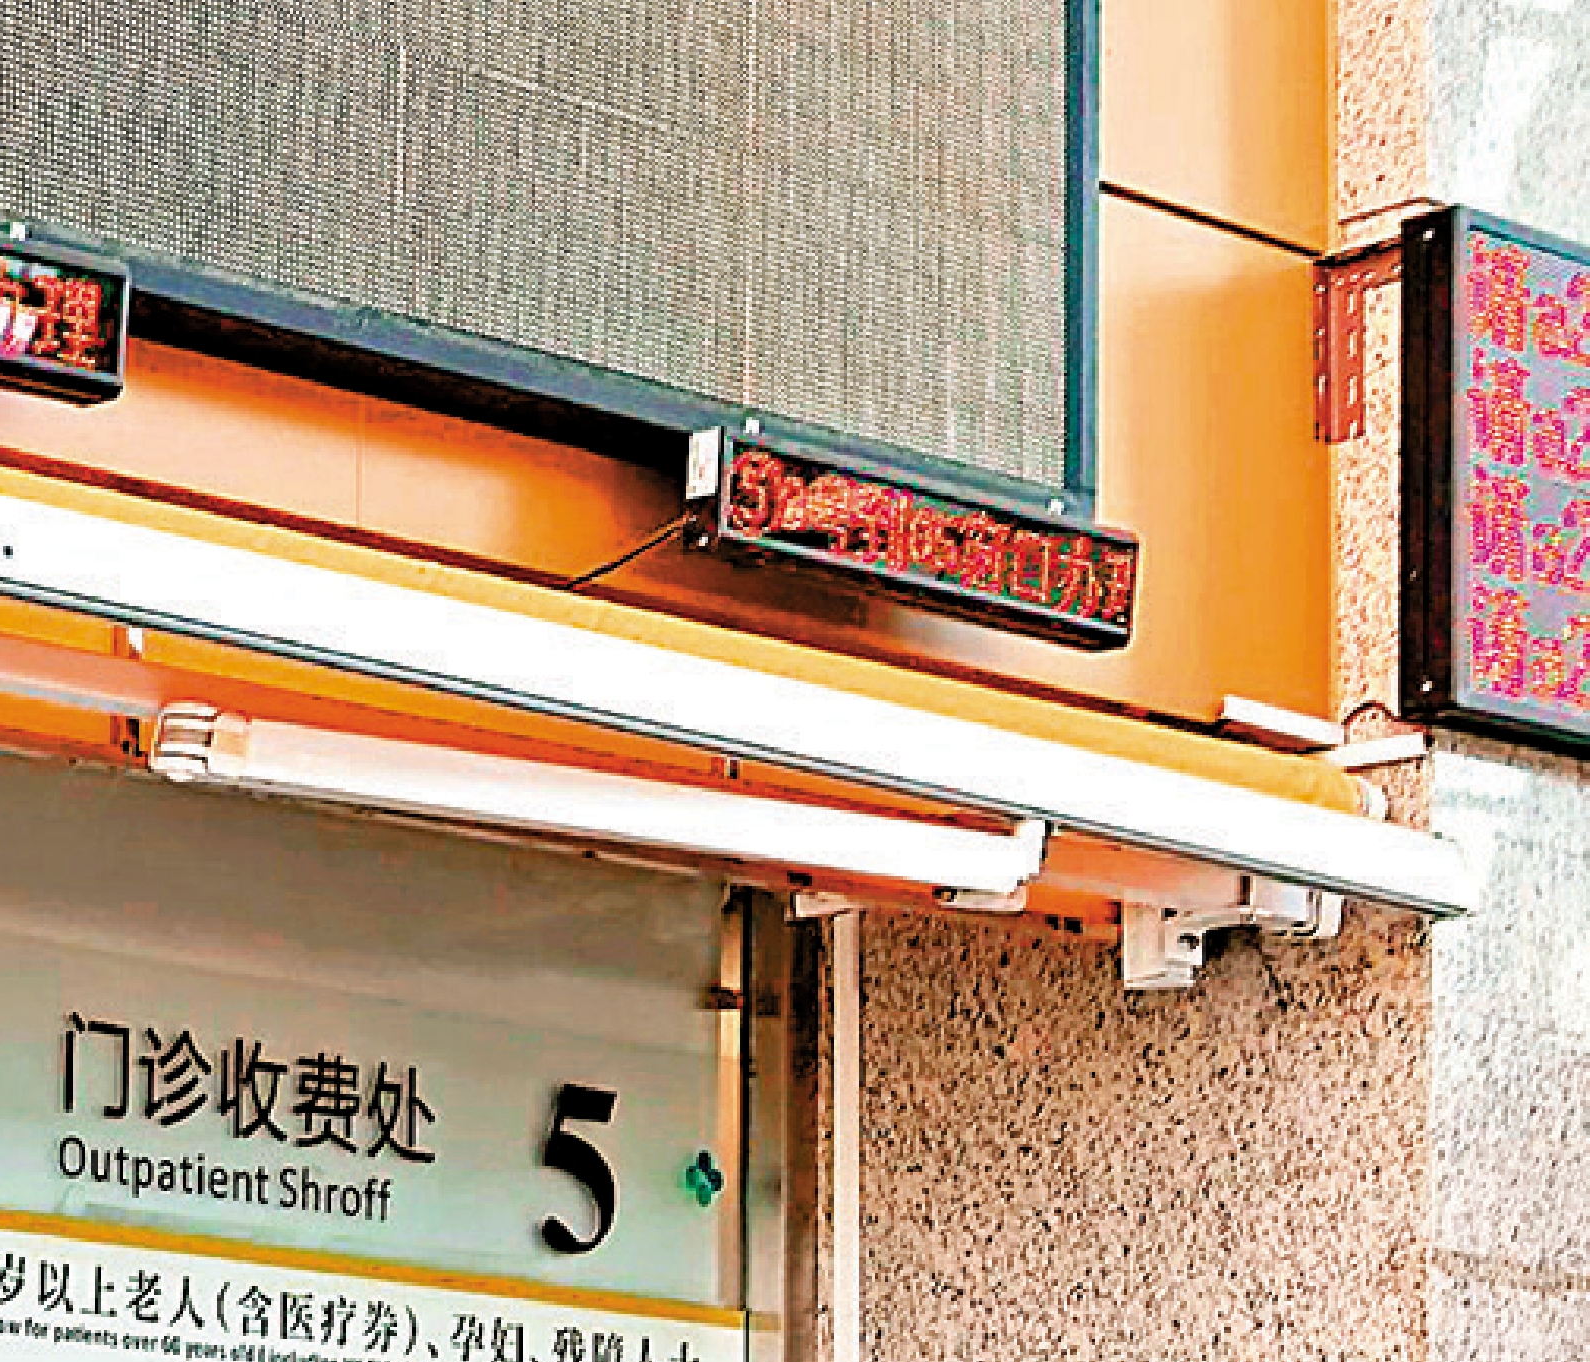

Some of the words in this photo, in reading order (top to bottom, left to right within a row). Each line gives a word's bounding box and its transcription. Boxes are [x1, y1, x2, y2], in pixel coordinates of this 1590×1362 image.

[63, 1011, 435, 1164] 门诊收费处
[57, 1135, 271, 1205] Outpatient
[279, 1166, 390, 1223] Shroff
[532, 1081, 617, 1254] 5
